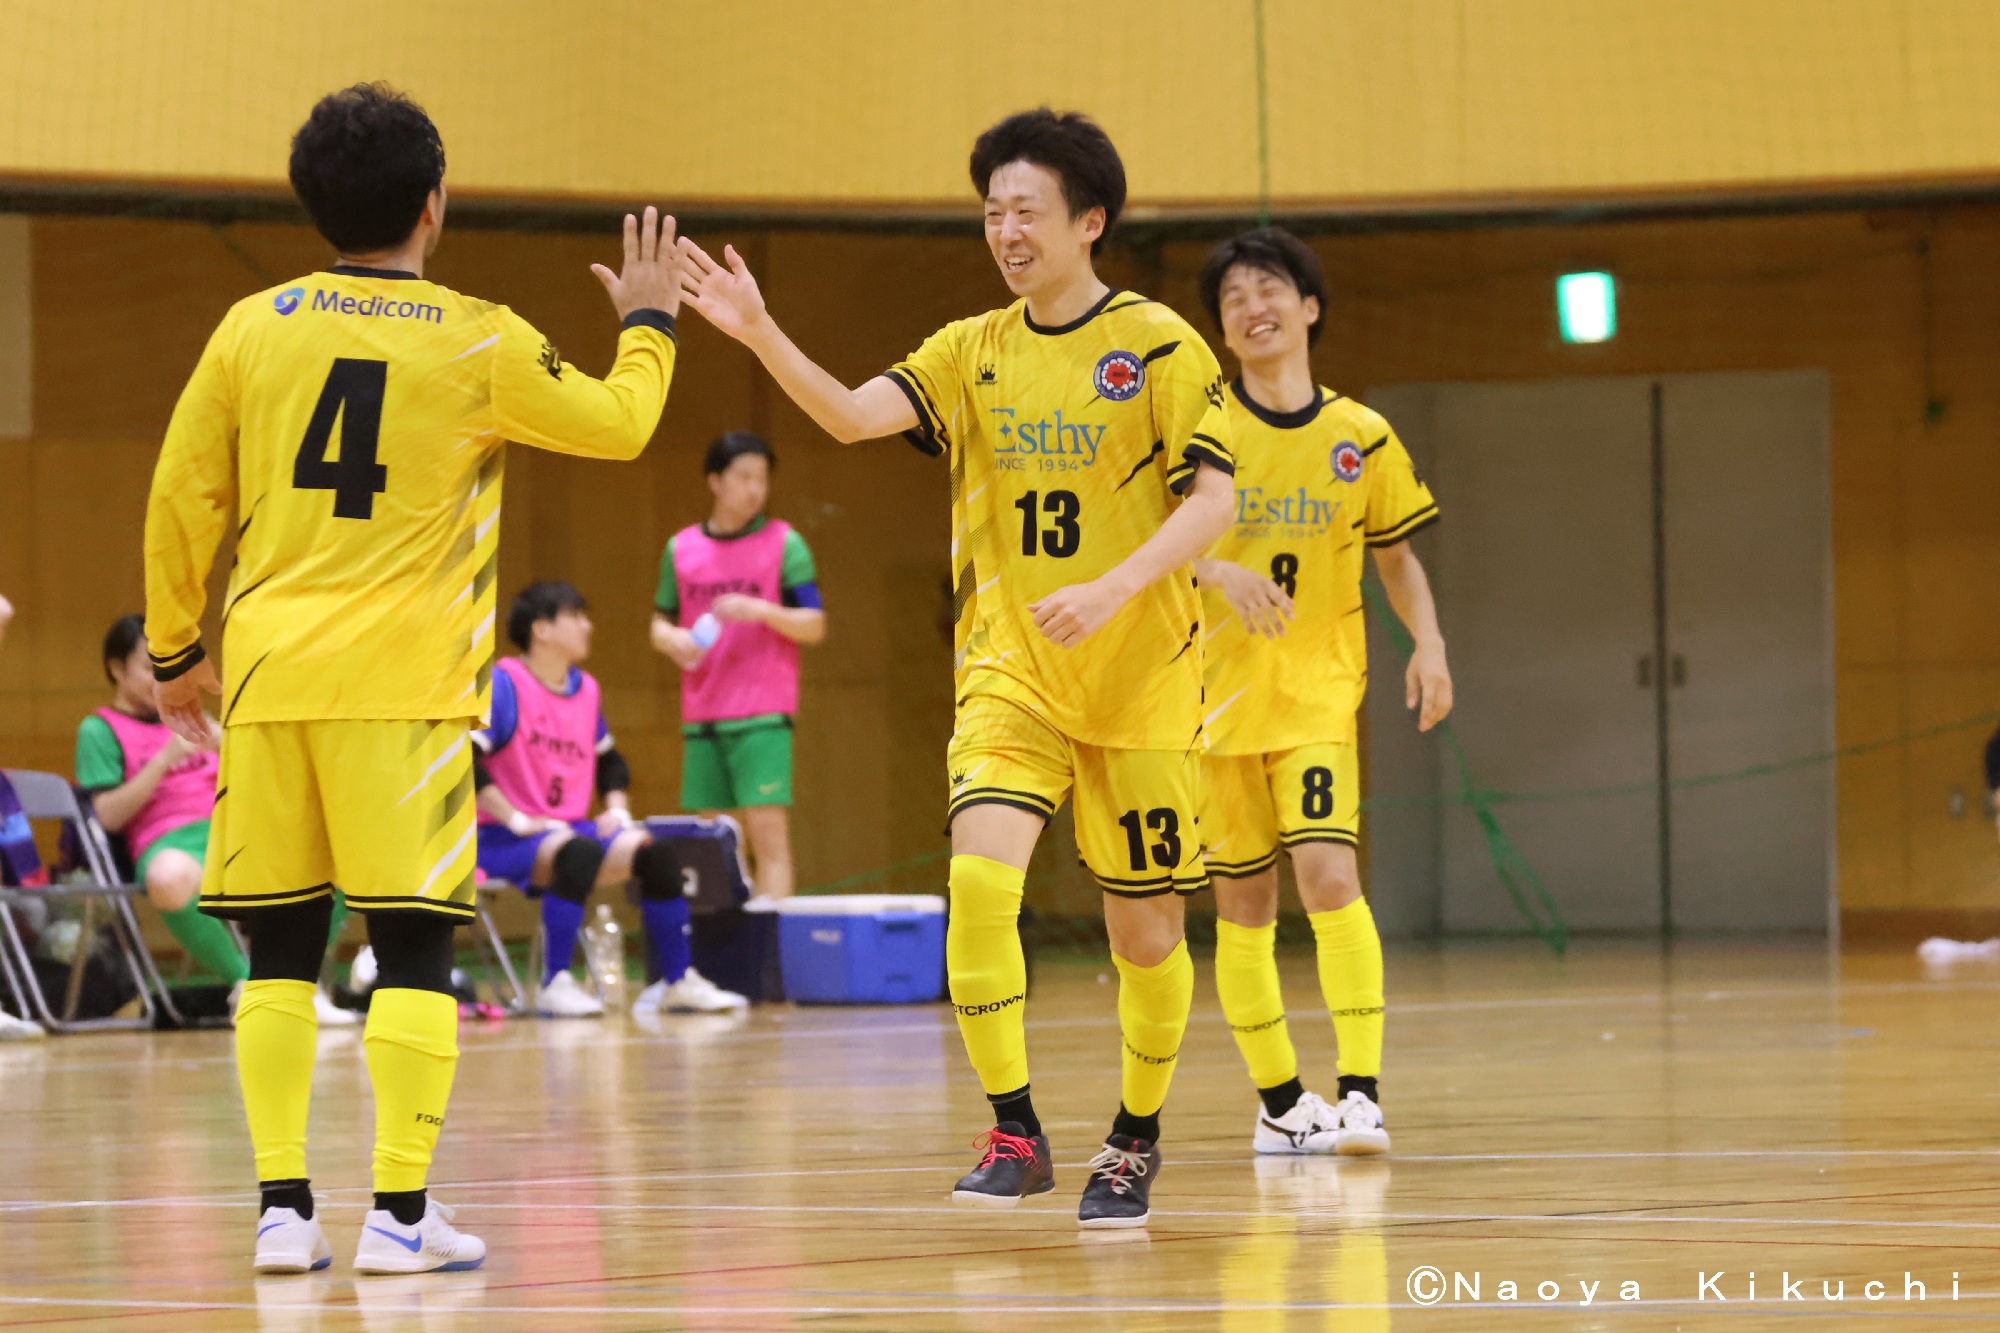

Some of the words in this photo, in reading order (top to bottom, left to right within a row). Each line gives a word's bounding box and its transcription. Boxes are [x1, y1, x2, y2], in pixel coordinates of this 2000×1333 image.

[311, 288, 444, 324] Medicom
[292, 357, 388, 520] 4
[990, 408, 1107, 467] Esthy
[994, 457, 1026, 471] INCE
[1037, 458, 1079, 472] 1994
[1014, 489, 1081, 559] 13
[1235, 487, 1341, 535] Esthy
[1271, 552, 1299, 600] 8
[1301, 766, 1334, 820] 8
[1118, 806, 1182, 872] 13
